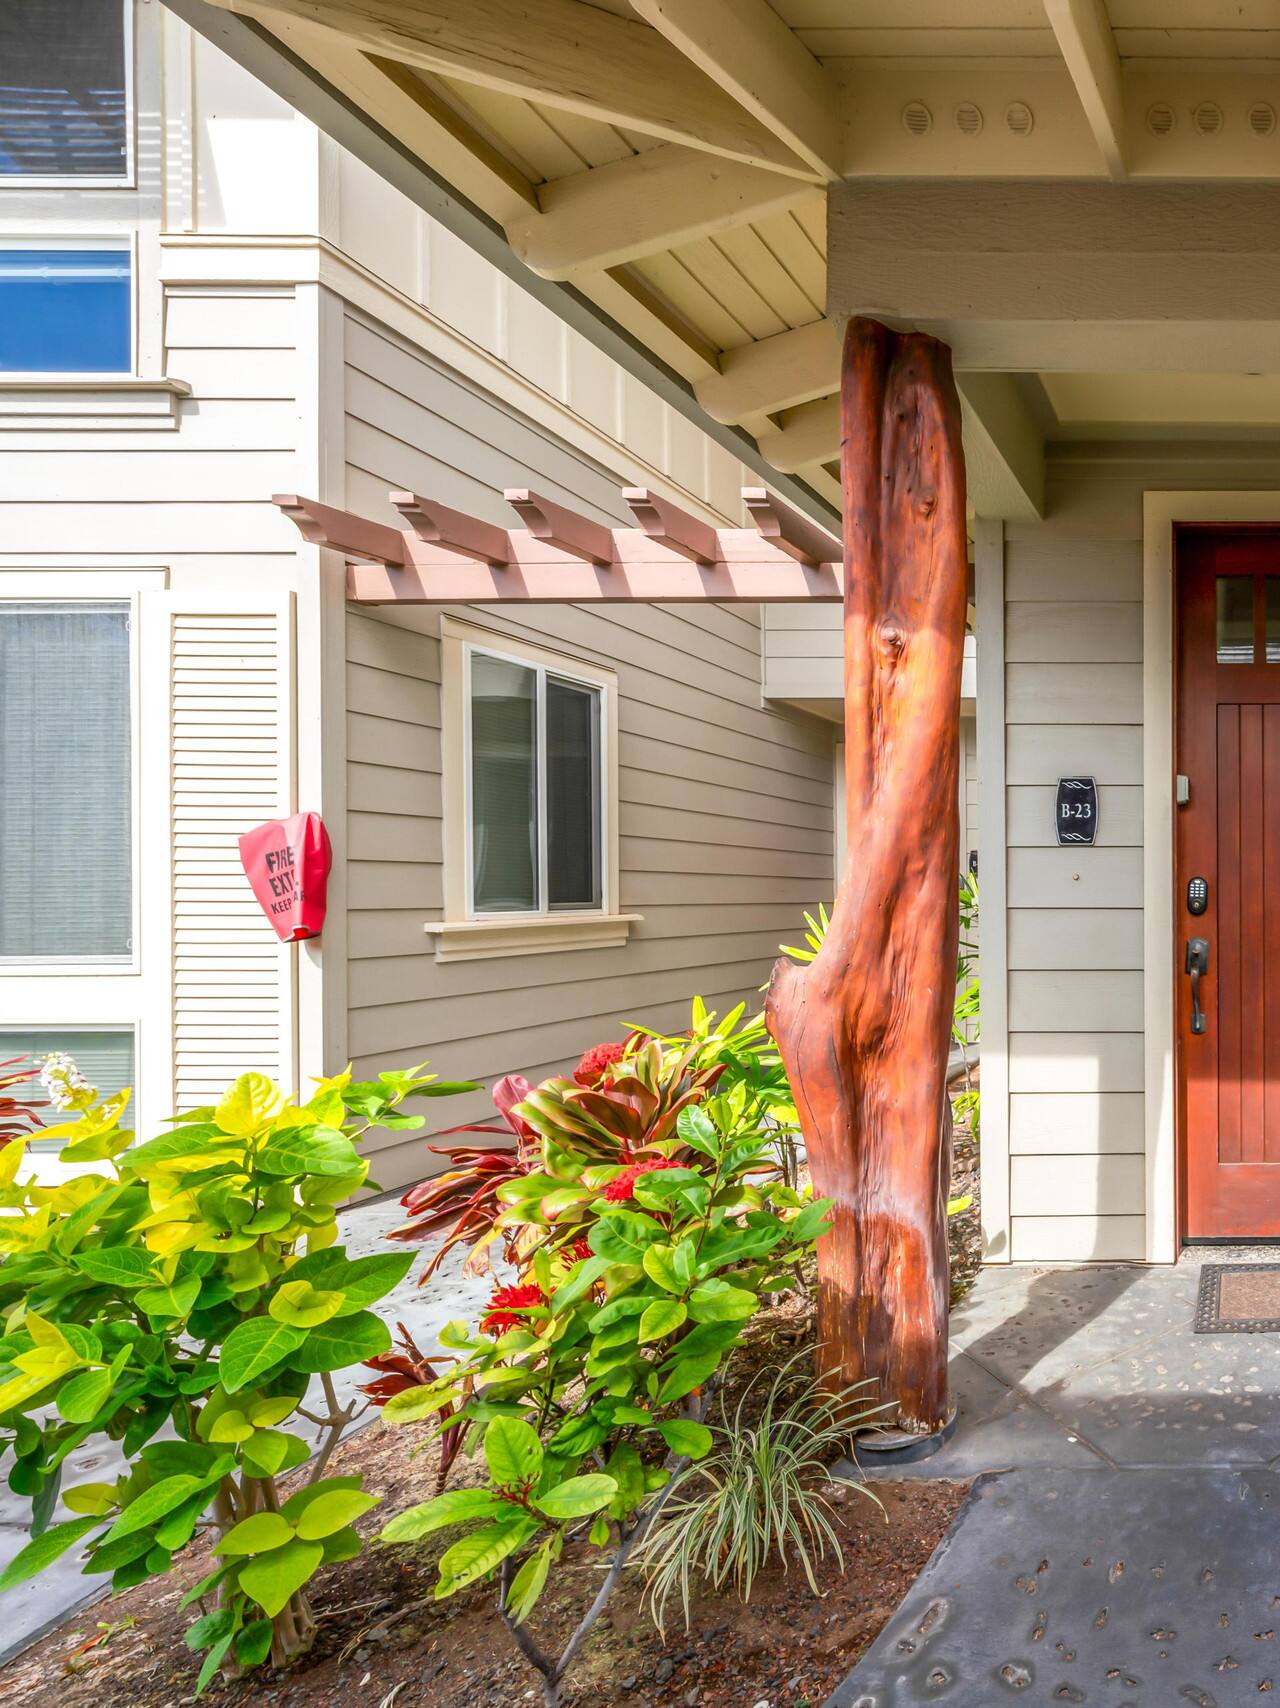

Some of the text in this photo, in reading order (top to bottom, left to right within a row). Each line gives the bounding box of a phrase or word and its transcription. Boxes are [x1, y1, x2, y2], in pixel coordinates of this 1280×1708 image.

[1061, 803, 1091, 818] B-23
[265, 846, 295, 873] FIRE
[271, 898, 292, 915] KEEP
